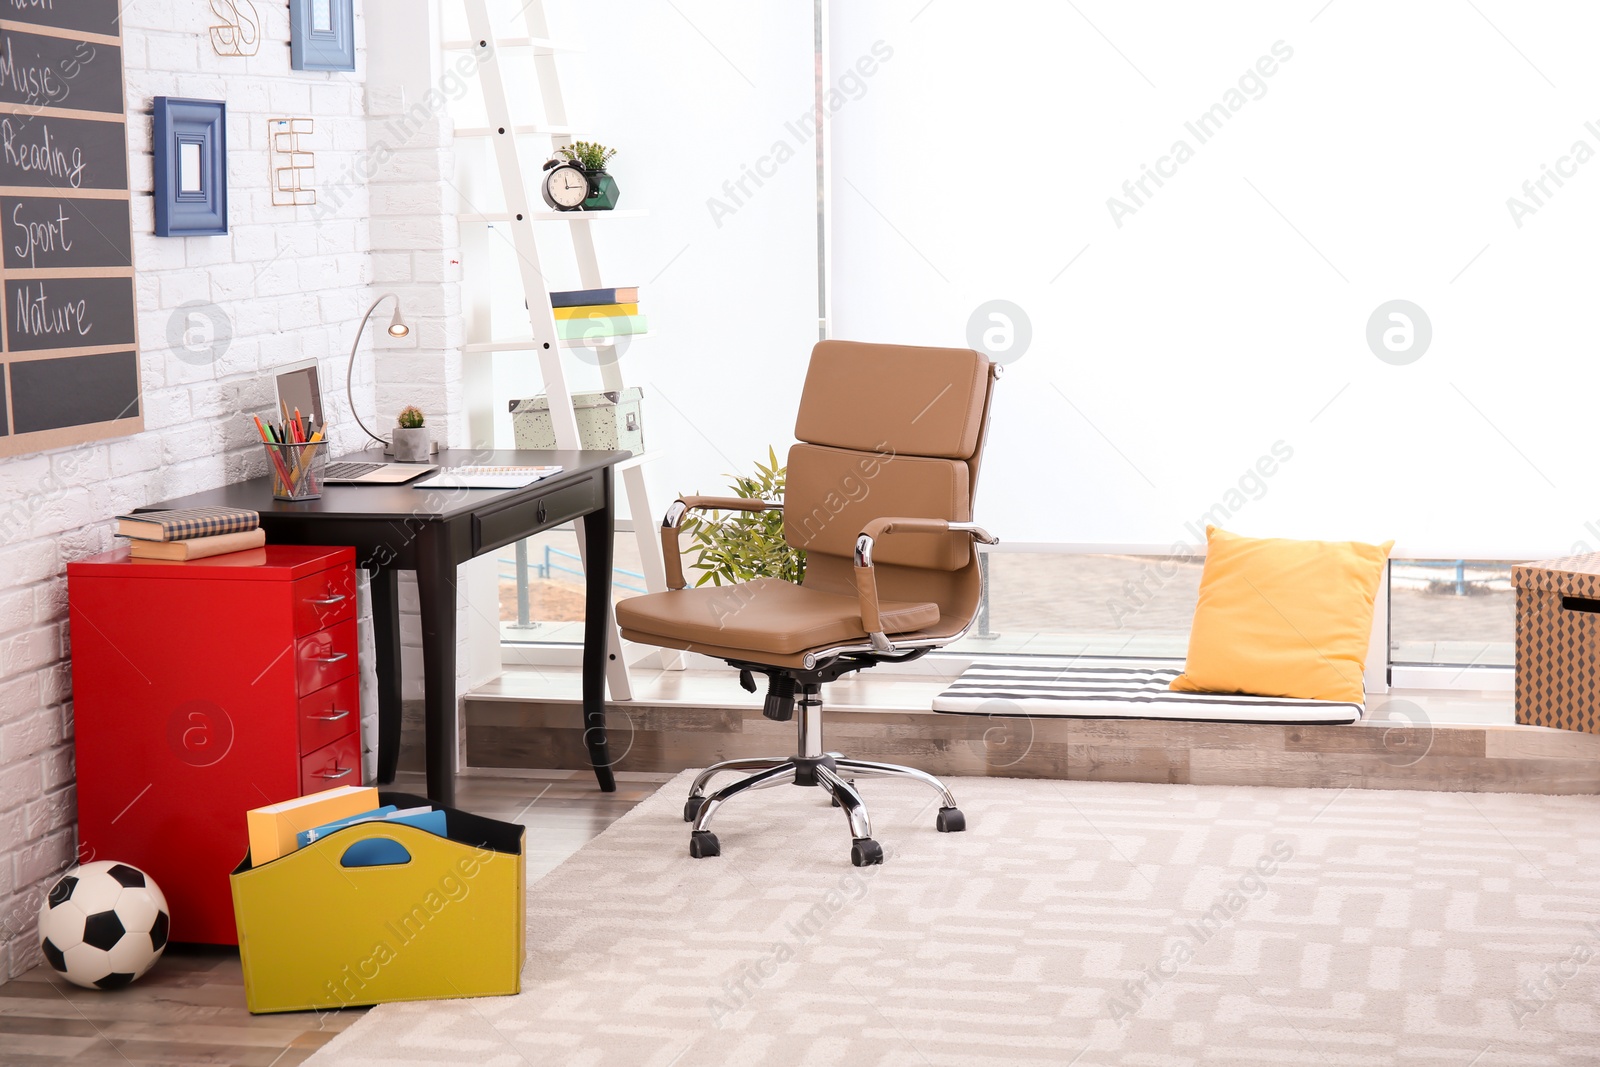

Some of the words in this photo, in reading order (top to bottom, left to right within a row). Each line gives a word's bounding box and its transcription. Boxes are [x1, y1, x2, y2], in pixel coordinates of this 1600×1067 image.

[0, 36, 56, 97] Music
[1, 118, 87, 188] Reading
[12, 202, 73, 269] Sport
[16, 281, 93, 336] Nature
